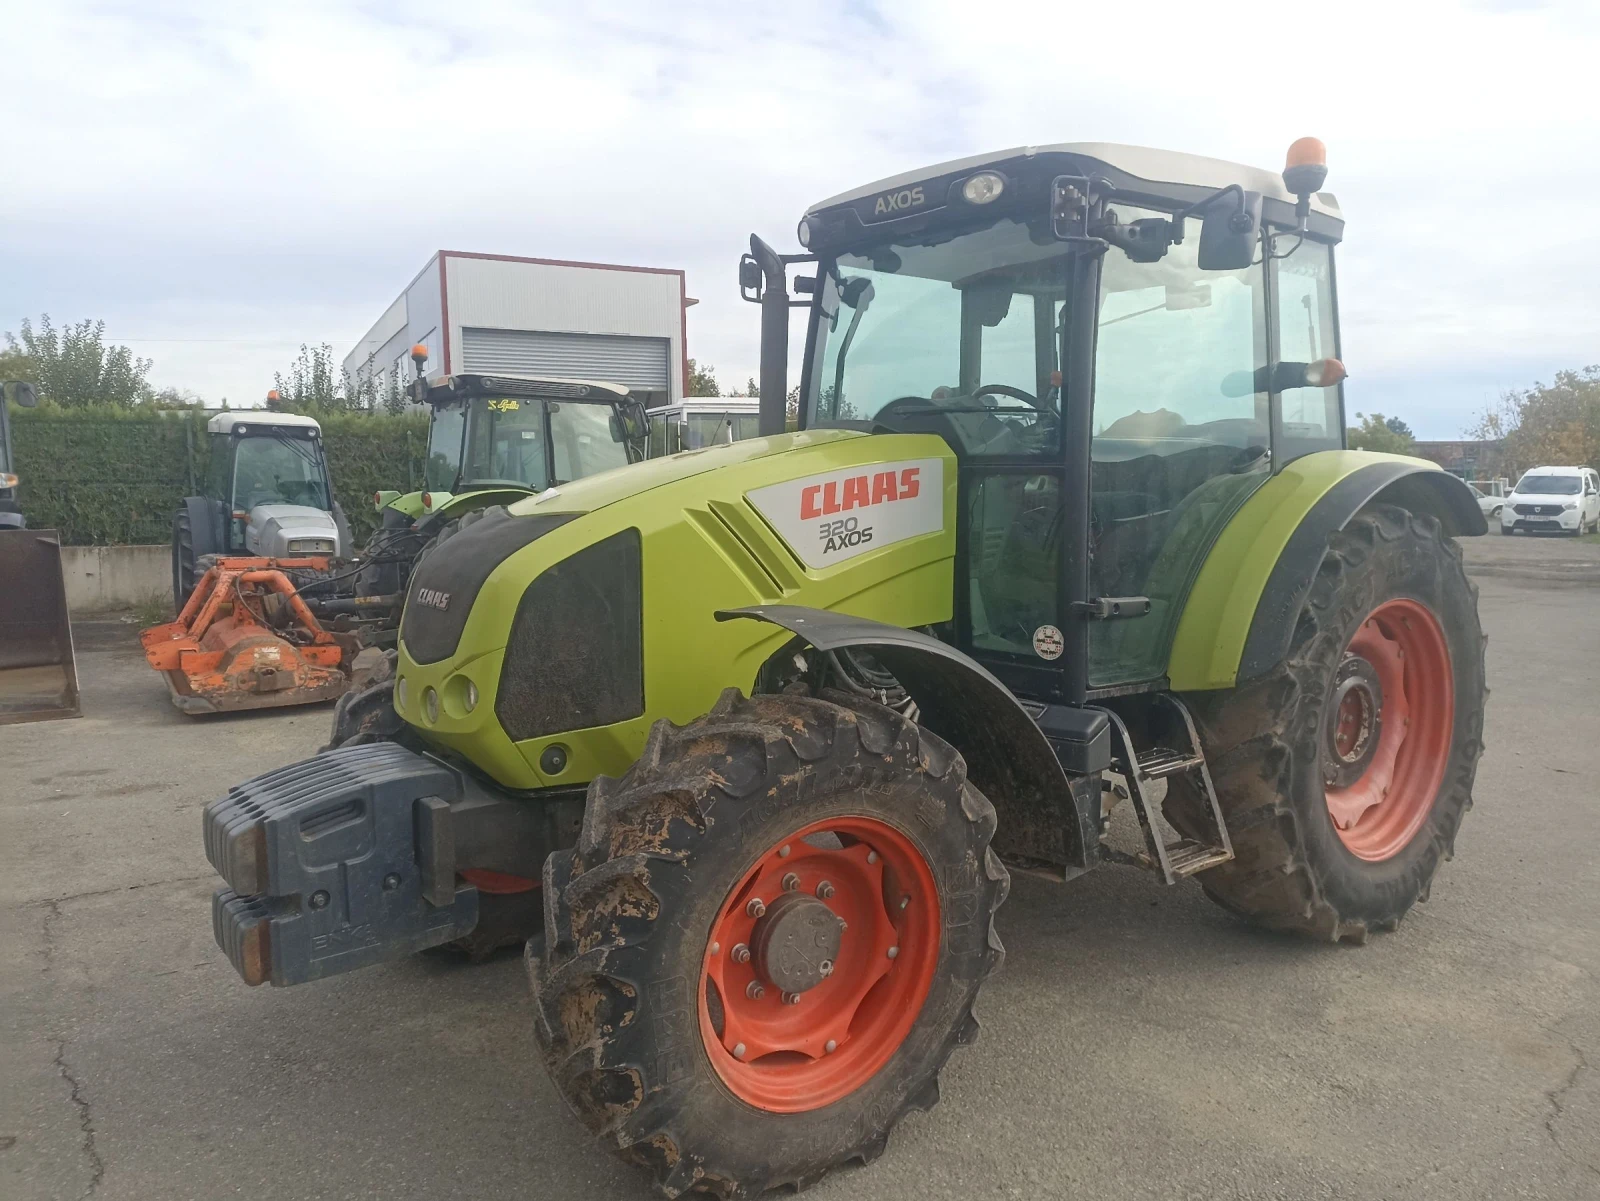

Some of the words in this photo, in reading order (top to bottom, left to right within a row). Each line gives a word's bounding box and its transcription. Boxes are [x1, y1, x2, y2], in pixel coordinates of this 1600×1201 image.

[875, 187, 925, 215] AXOS
[801, 468, 920, 520] CLAAS
[819, 516, 858, 540] 320
[823, 527, 872, 554] AXOS
[417, 588, 450, 609] CLAAS
